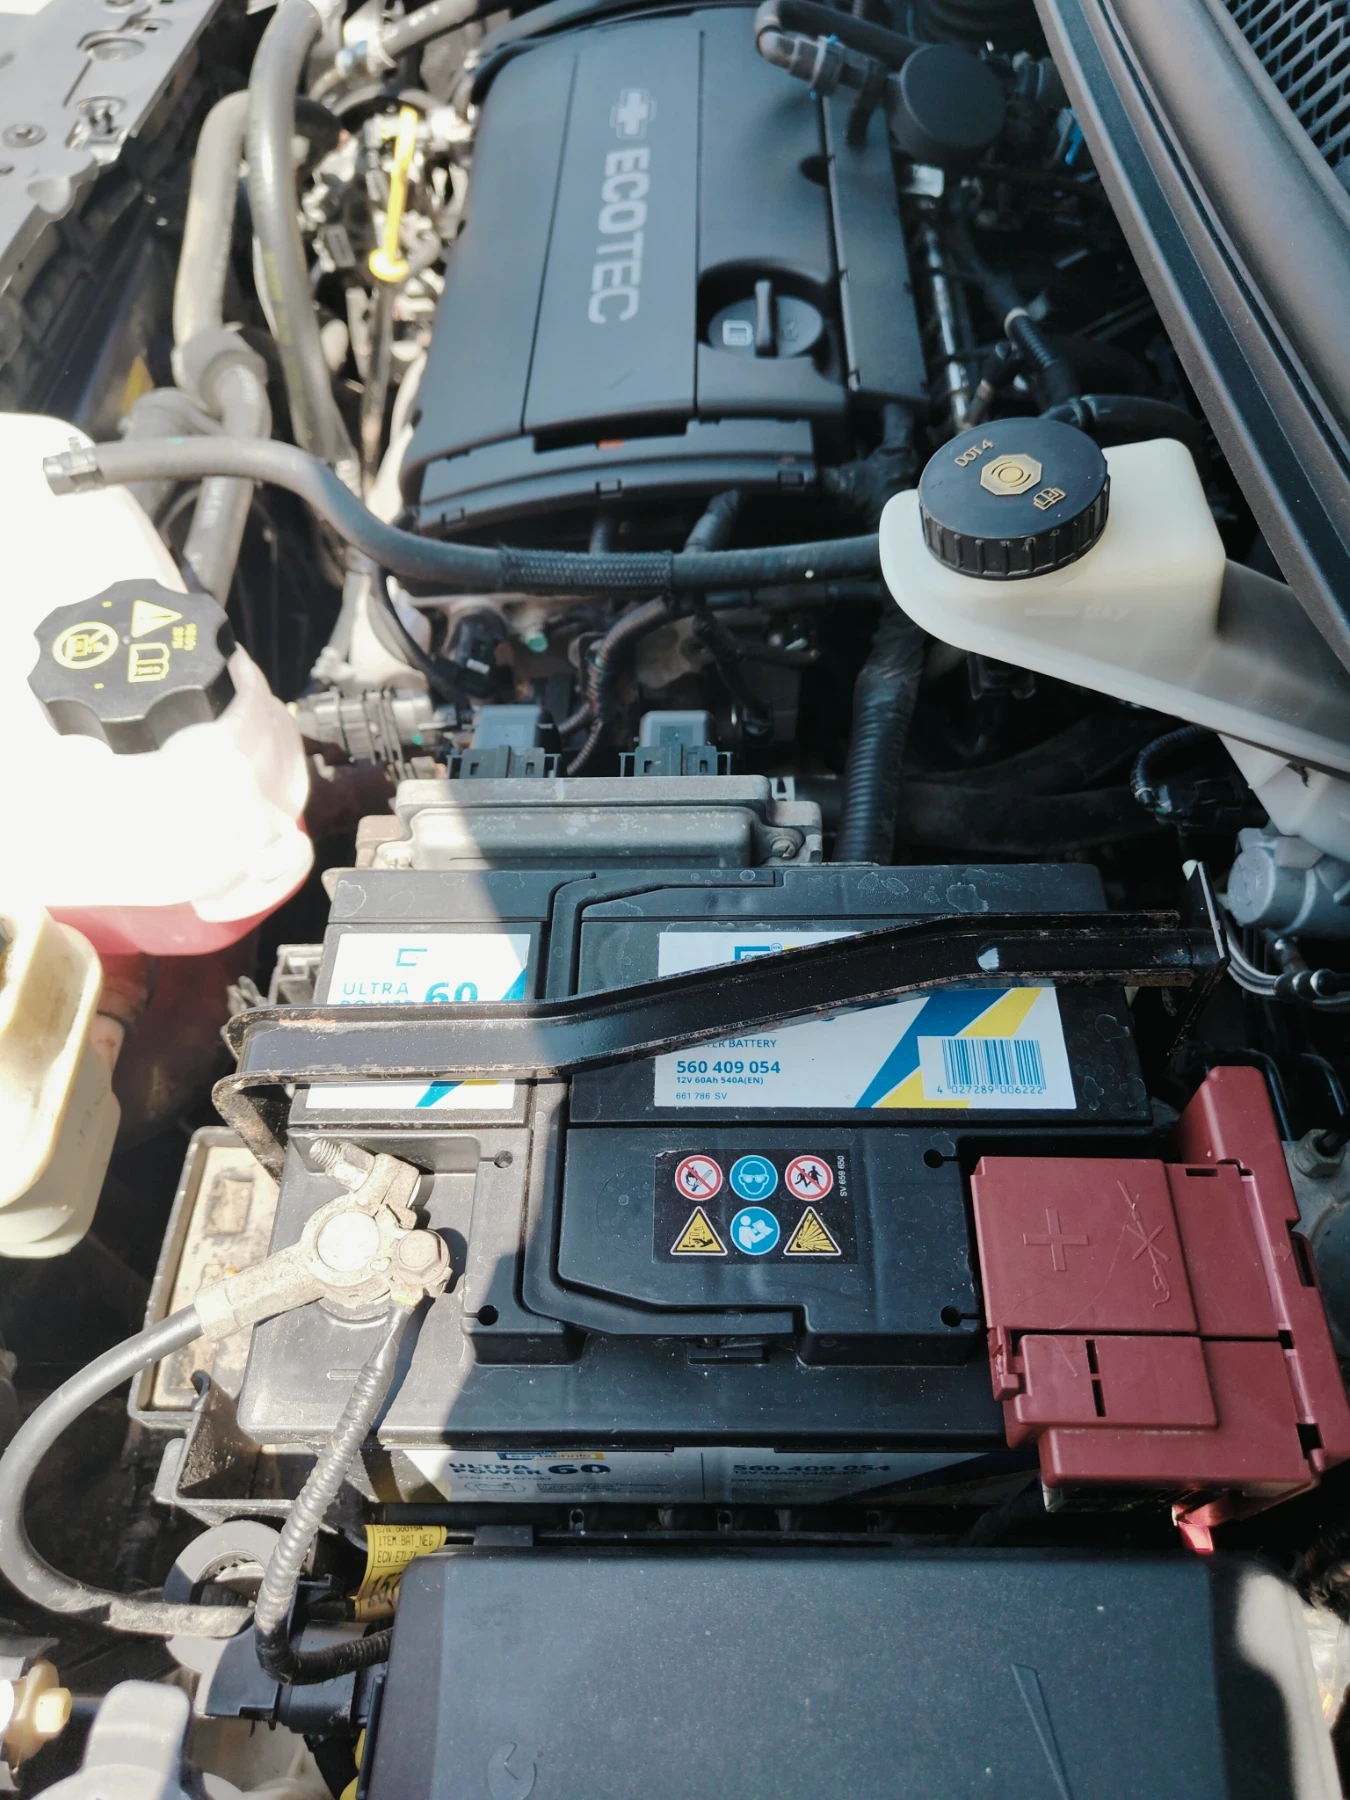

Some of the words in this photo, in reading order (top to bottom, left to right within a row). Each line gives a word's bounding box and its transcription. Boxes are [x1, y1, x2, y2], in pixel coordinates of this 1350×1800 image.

[588, 147, 650, 324] ECOTEC
[953, 445, 983, 467] DOT
[981, 438, 995, 451] 4
[342, 982, 409, 996] ULTRA
[425, 981, 479, 1003] 60
[728, 1039, 777, 1048] BATTERY
[676, 1060, 708, 1074] 560
[712, 1060, 744, 1074] 409
[749, 1060, 781, 1074] 054
[676, 1076, 693, 1084] 12V
[694, 1076, 719, 1084] 60Ah
[720, 1076, 764, 1085] 540A(EN)
[675, 1092, 691, 1100] 661
[694, 1092, 711, 1100] 786
[714, 1092, 728, 1100] SV
[936, 1084, 944, 1093] 4
[951, 1084, 995, 1095] 027289
[1000, 1084, 1044, 1095] 006222
[837, 1155, 845, 1169] 650
[838, 1170, 846, 1185] 659
[839, 1187, 847, 1197] SV
[548, 1463, 611, 1475] 60
[787, 1464, 836, 1472] 409
[843, 1464, 891, 1472] 054
